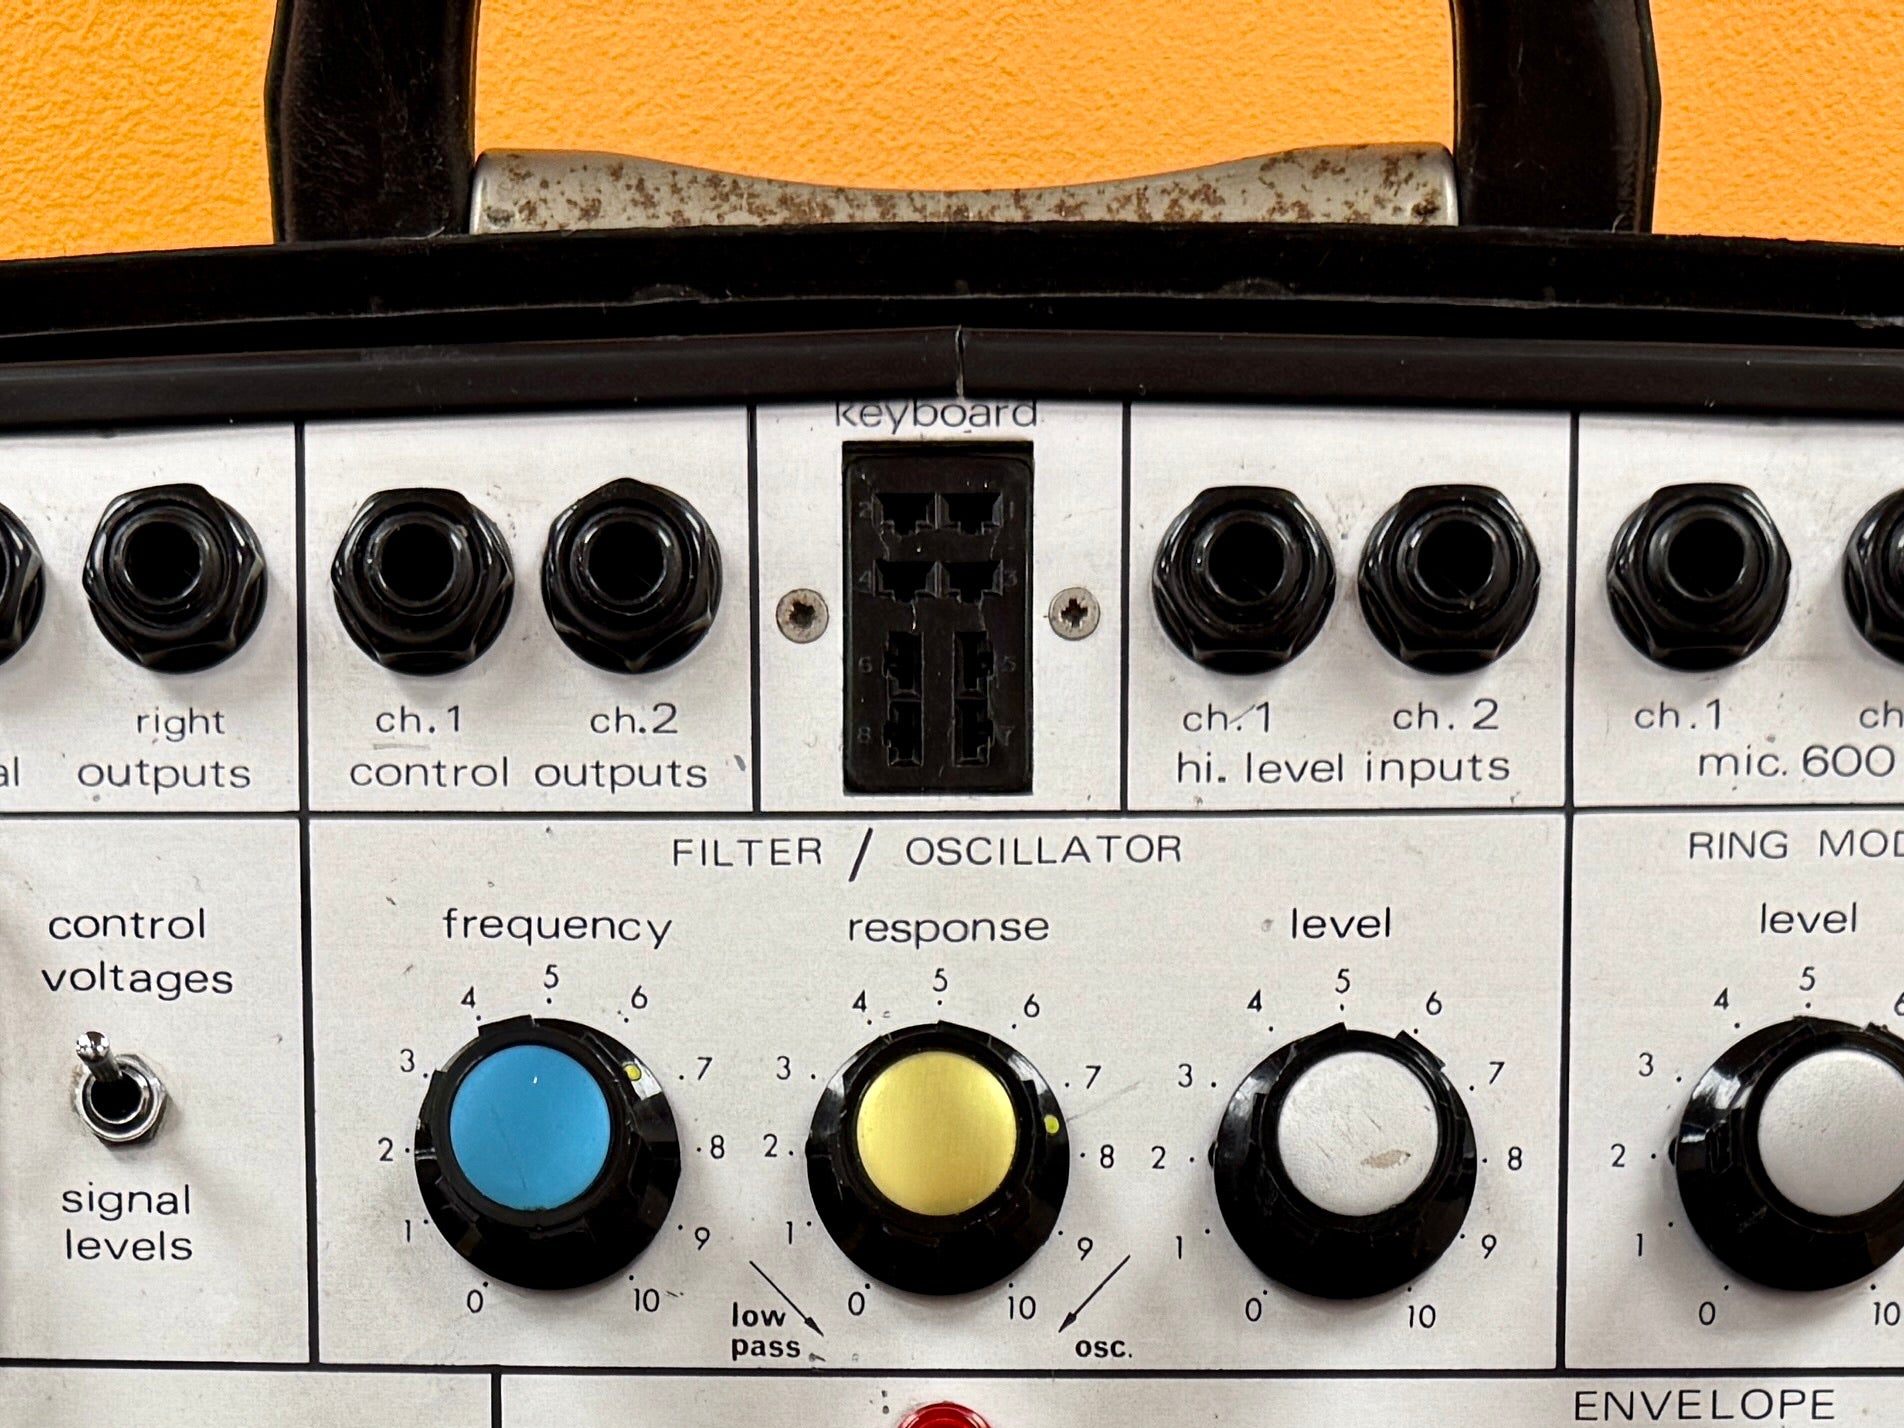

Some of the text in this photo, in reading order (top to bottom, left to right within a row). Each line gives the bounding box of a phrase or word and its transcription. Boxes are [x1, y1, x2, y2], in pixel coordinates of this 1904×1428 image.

[834, 400, 1038, 433] keyboard
[136, 705, 226, 744] right
[375, 703, 460, 734] ch.1
[589, 701, 679, 734] ch.2
[1472, 697, 1499, 730] 2
[1634, 697, 1721, 730] ch.1
[77, 758, 251, 796] outputs
[349, 755, 708, 795] control outputs
[1177, 749, 1510, 789] hi. level inputs
[1698, 744, 1788, 778] mic.
[1802, 743, 1896, 778] 600
[673, 833, 1181, 867] FILTER OSCILLATOR
[1689, 829, 1788, 860] RING
[48, 906, 205, 941] control
[442, 907, 673, 950] frequency
[848, 917, 1050, 951] response
[1291, 905, 1391, 940] level
[1760, 901, 1857, 934] level
[40, 959, 233, 1002] voltages
[543, 963, 560, 990] 5
[709, 1134, 726, 1160] 8
[61, 1181, 190, 1222] signal
[65, 1227, 193, 1262] levels
[466, 1288, 484, 1314] 0
[633, 1287, 660, 1313] 10
[731, 1301, 787, 1328] low
[731, 1337, 801, 1362] pass
[1074, 1339, 1133, 1359] osc.
[1574, 1388, 1835, 1422] ENVELOPE
